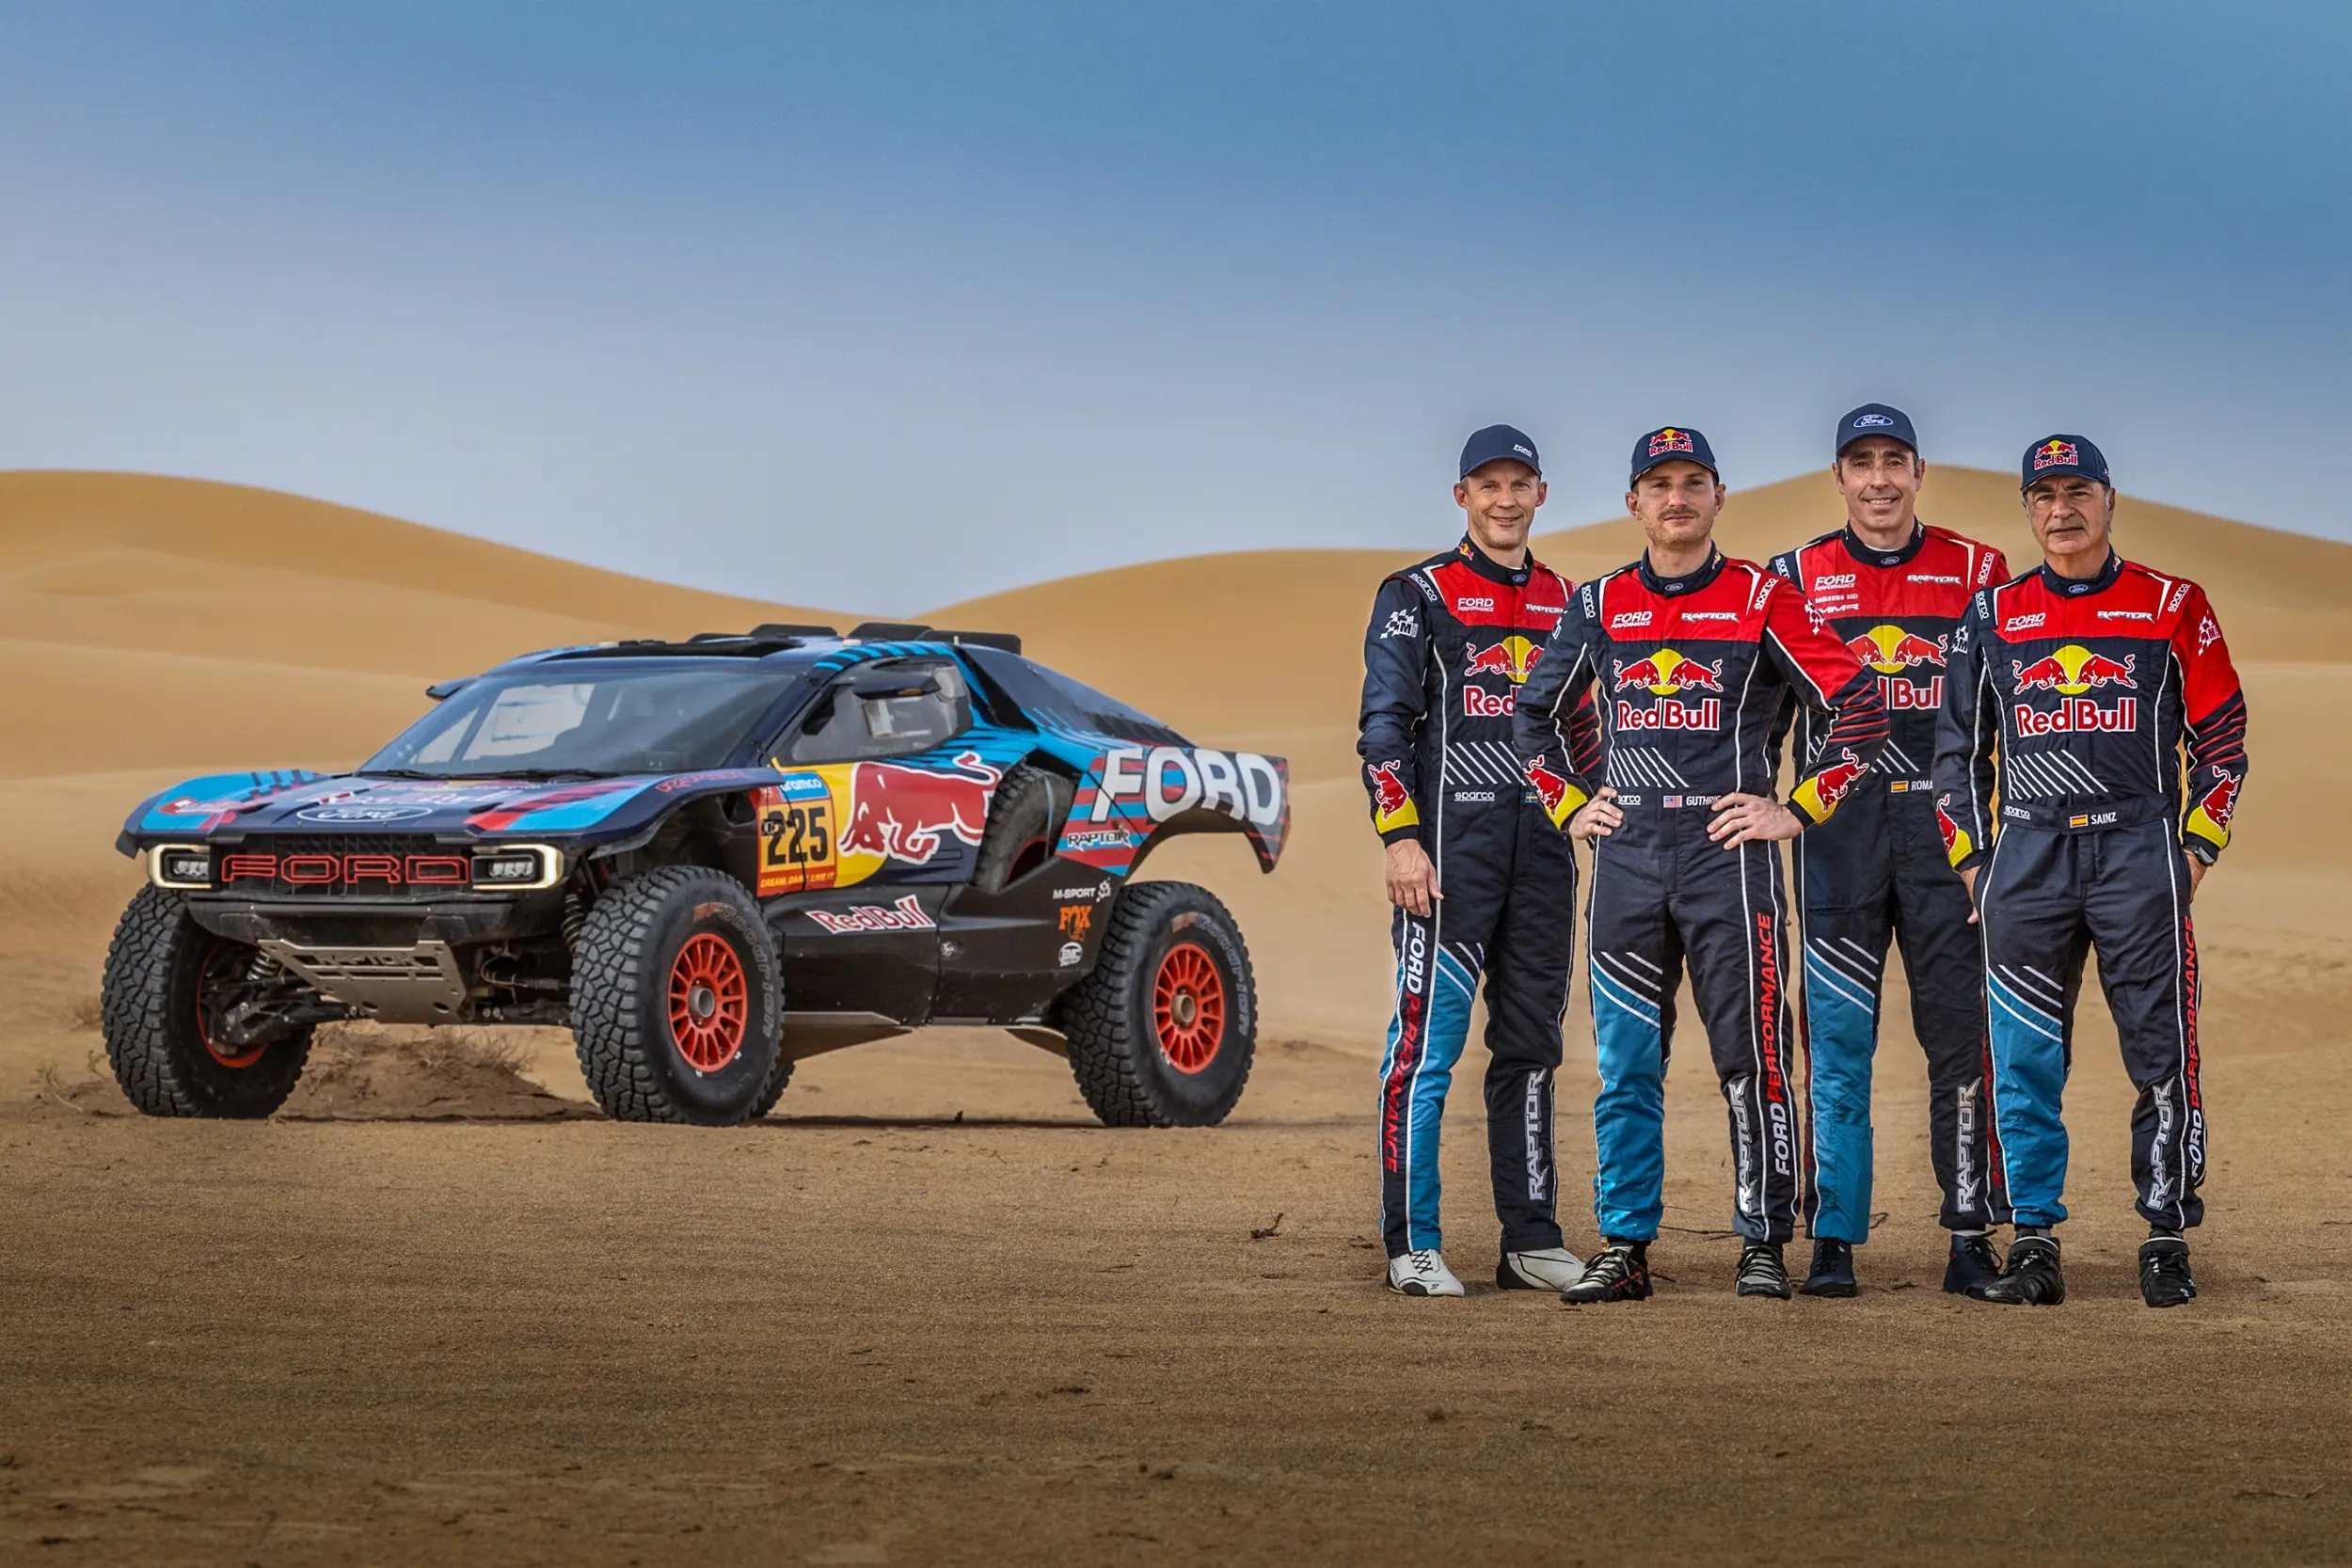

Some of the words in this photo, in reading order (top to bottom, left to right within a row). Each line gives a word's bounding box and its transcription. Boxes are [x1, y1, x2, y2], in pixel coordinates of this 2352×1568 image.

[1649, 441, 1671, 457] Red
[1671, 441, 1692, 452] Bull
[2034, 455, 2055, 470] Red
[2055, 454, 2077, 466] Bull
[1815, 574, 1856, 588] FORD
[1907, 575, 1963, 587] RAPTOR
[1978, 552, 1994, 585] sparco
[1408, 573, 1438, 602] sparco
[1457, 597, 1494, 607] FORD
[1581, 585, 1596, 619] sparco
[1754, 578, 1779, 610] sparco
[2168, 584, 2190, 612] sparco
[1612, 611, 1653, 625] FORD
[1681, 612, 1740, 623] RAPTOR
[1976, 591, 1989, 620] sparco
[2007, 612, 2046, 627] FORD
[2097, 610, 2155, 624] RAPTOR
[1616, 697, 1661, 731] Red
[1662, 698, 1720, 731] Bull
[2014, 697, 2073, 737] Red
[2074, 697, 2137, 732] Bull
[1089, 746, 1280, 826] FORD
[1454, 791, 1495, 802] sparco
[1911, 779, 1933, 792] ROMA
[1617, 795, 1641, 806] arco
[2004, 805, 2030, 820] sparco
[2090, 812, 2117, 825] SAINZ
[766, 805, 829, 866] 225
[1066, 831, 1133, 853] RAPTOR
[221, 854, 470, 884] FORD
[1053, 887, 1096, 899] M-SPORT
[1058, 905, 1091, 930] FOX
[1406, 922, 1426, 994] FORD
[1757, 912, 1785, 1102] PERFORMANCE
[2185, 915, 2200, 1109] PERFORMANCE
[1384, 992, 1421, 1173] PERFORMANCE
[1526, 1068, 1548, 1201] RAPTOR
[1728, 1076, 1757, 1213] RAPTOR
[1770, 1102, 1789, 1175] FORD
[1956, 1076, 1982, 1213] RAPTOR
[2146, 1076, 2175, 1211] RAPTOR
[2188, 1109, 2202, 1178] FORD
